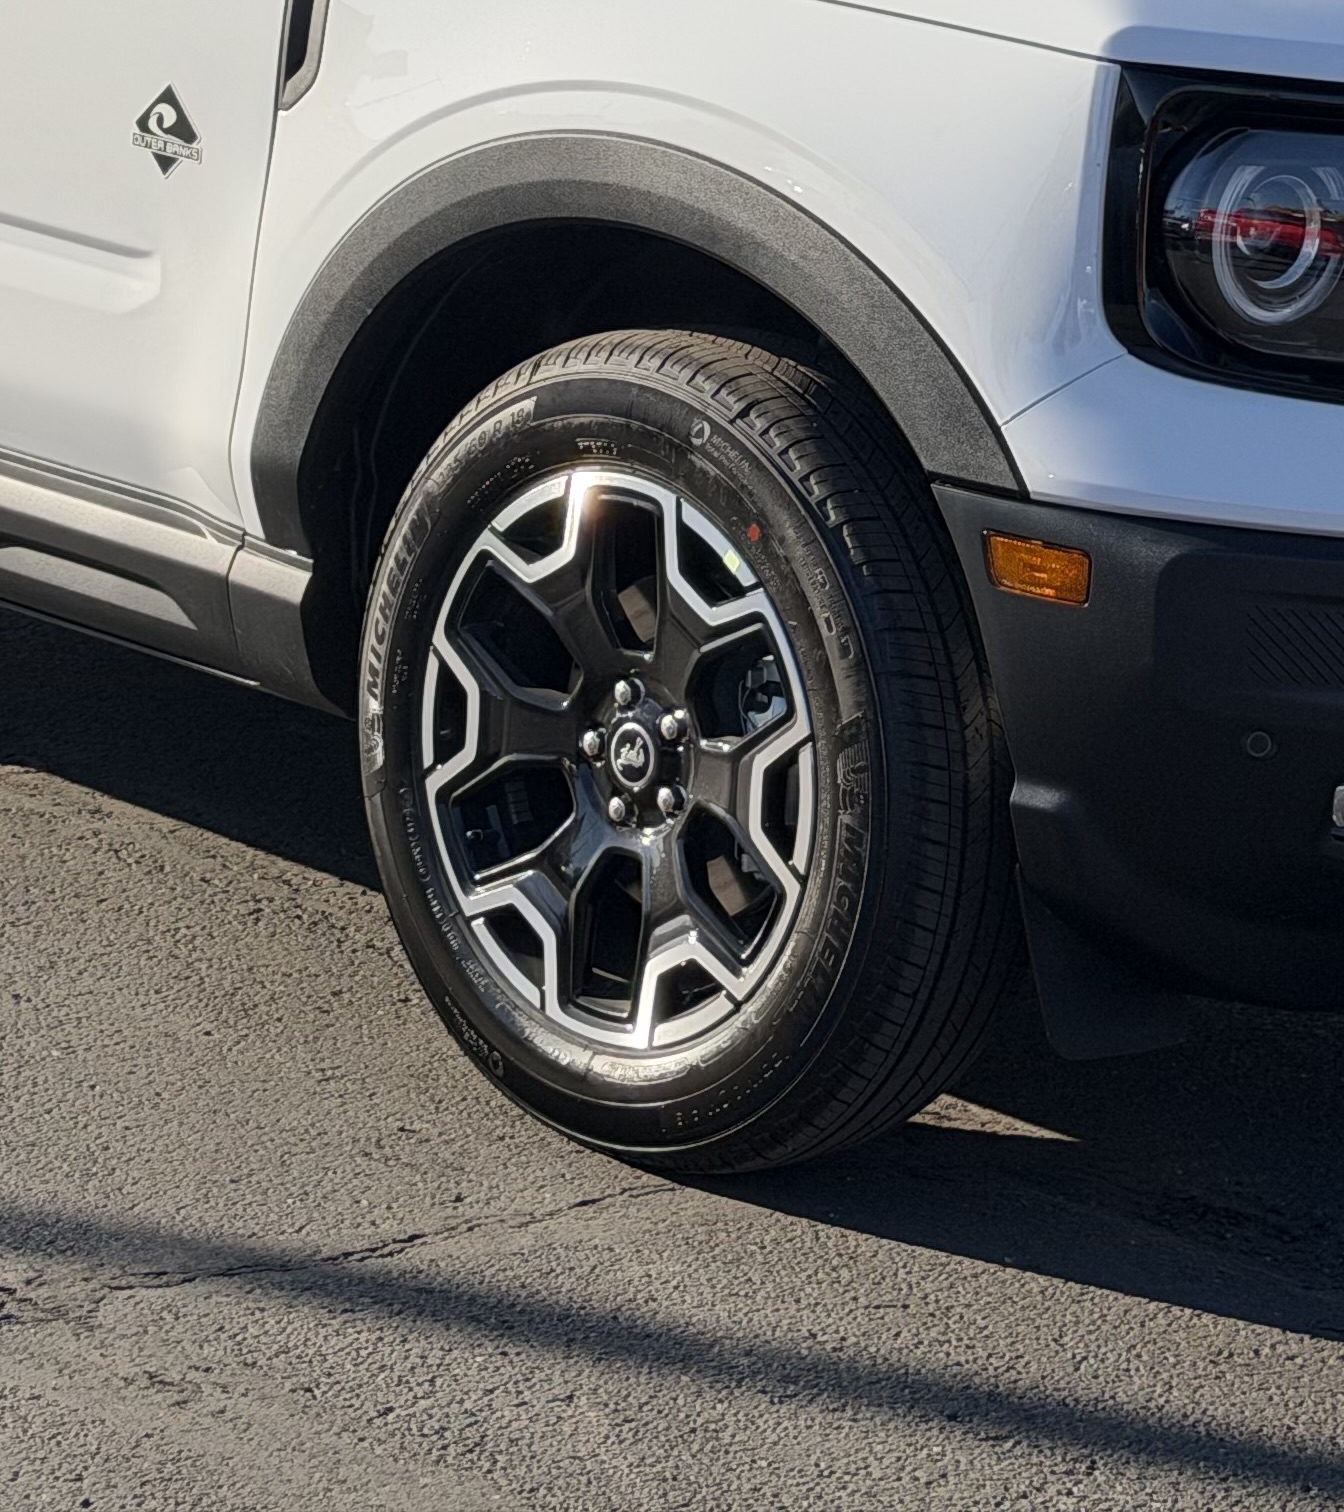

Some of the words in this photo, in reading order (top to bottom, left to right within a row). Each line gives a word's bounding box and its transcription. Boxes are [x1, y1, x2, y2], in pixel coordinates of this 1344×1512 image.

[133, 133, 165, 152] OUTER
[165, 142, 198, 160] BANKS
[366, 506, 431, 702] MICHELIN
